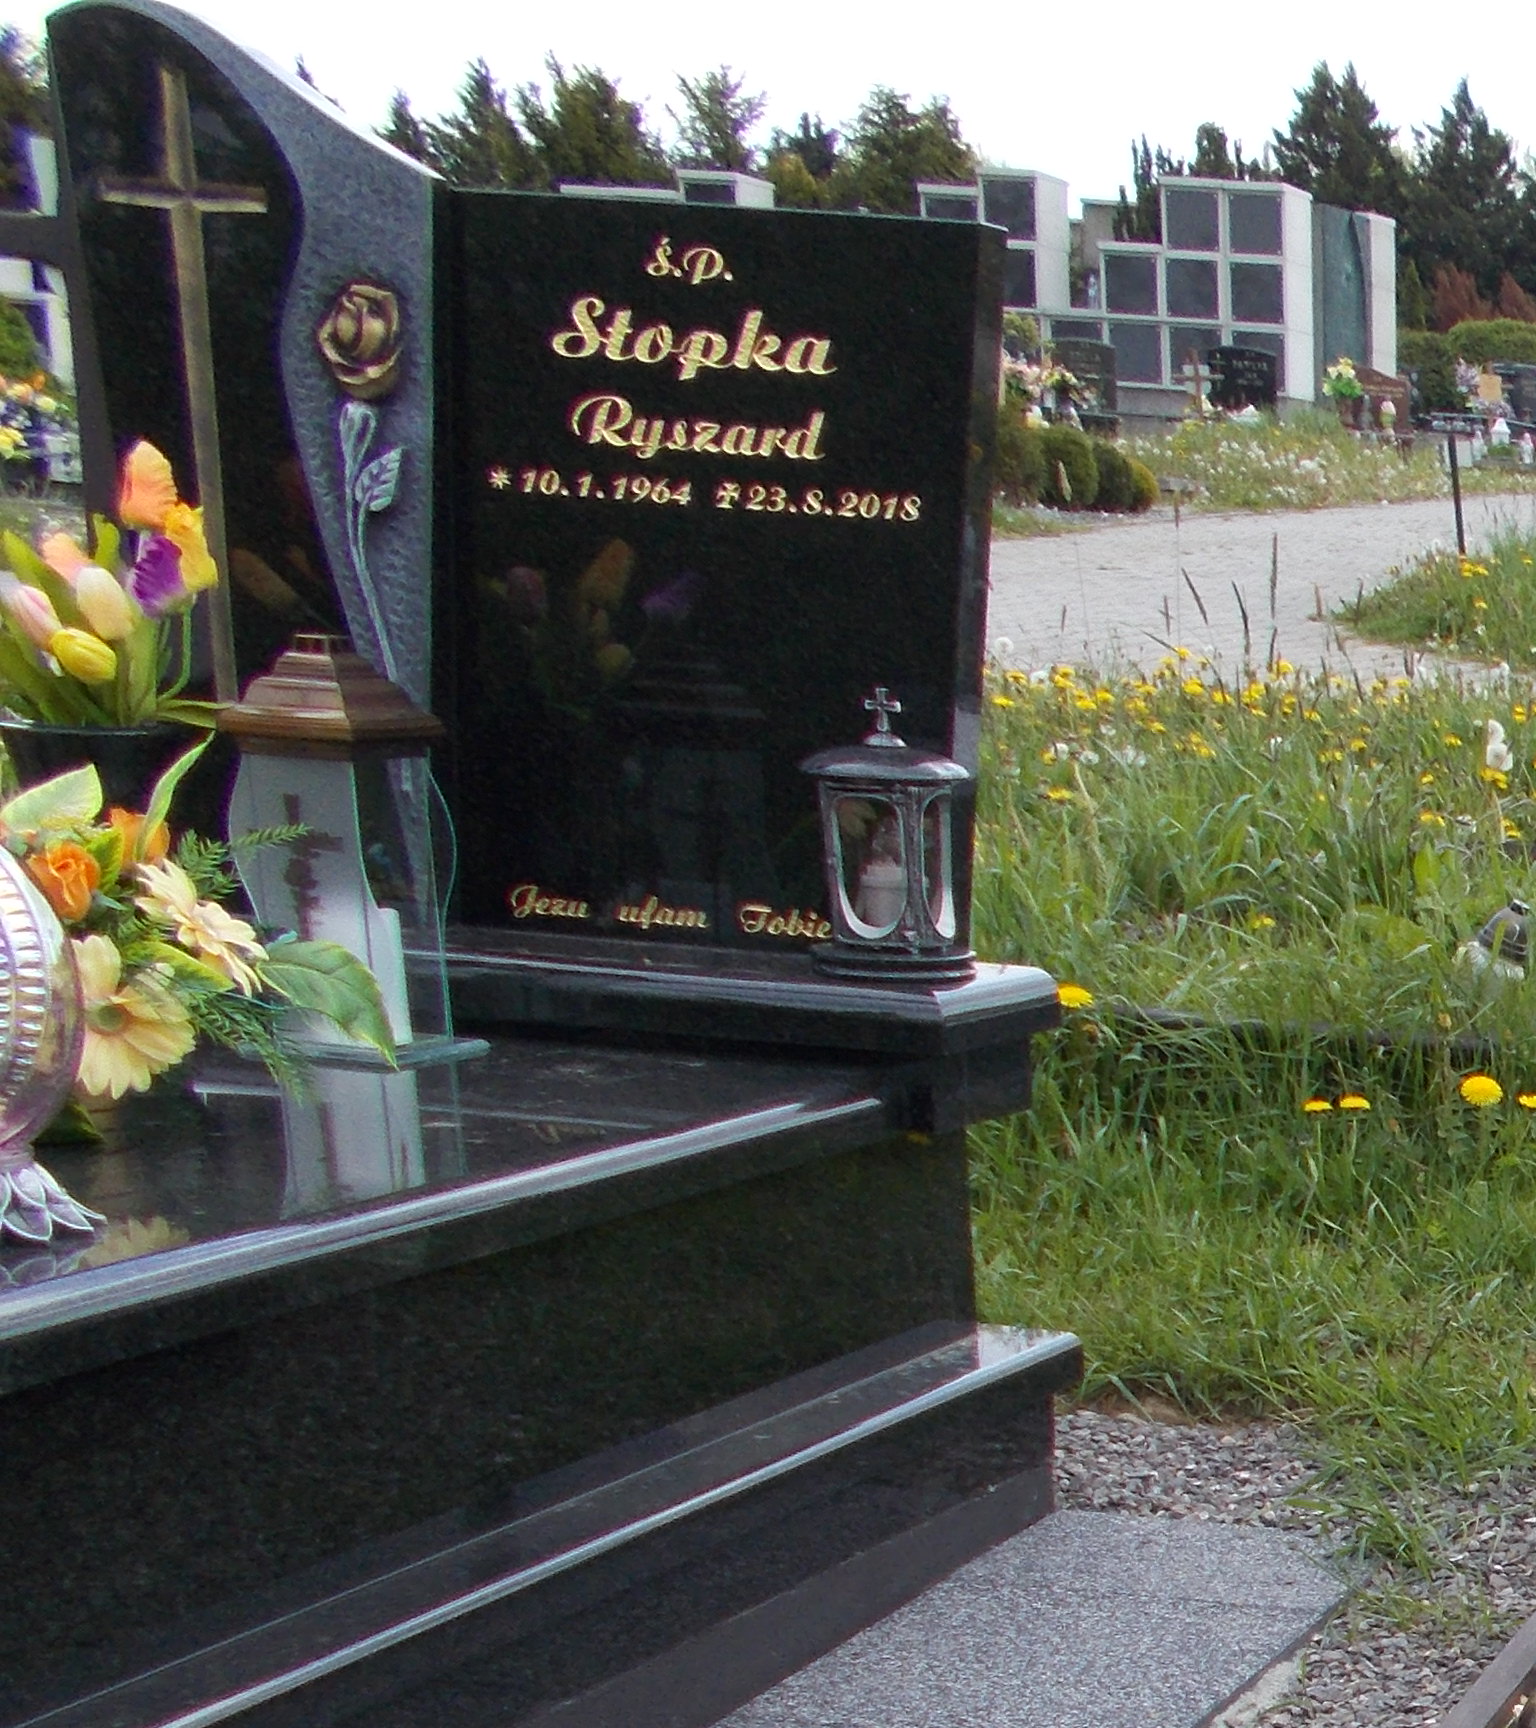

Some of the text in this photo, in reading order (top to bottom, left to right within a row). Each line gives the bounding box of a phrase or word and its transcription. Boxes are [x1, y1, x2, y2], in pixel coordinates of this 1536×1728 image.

[552, 297, 838, 381] Stopka
[571, 396, 825, 460] Ryszard
[511, 885, 833, 939] Jezu ufam Tobie
